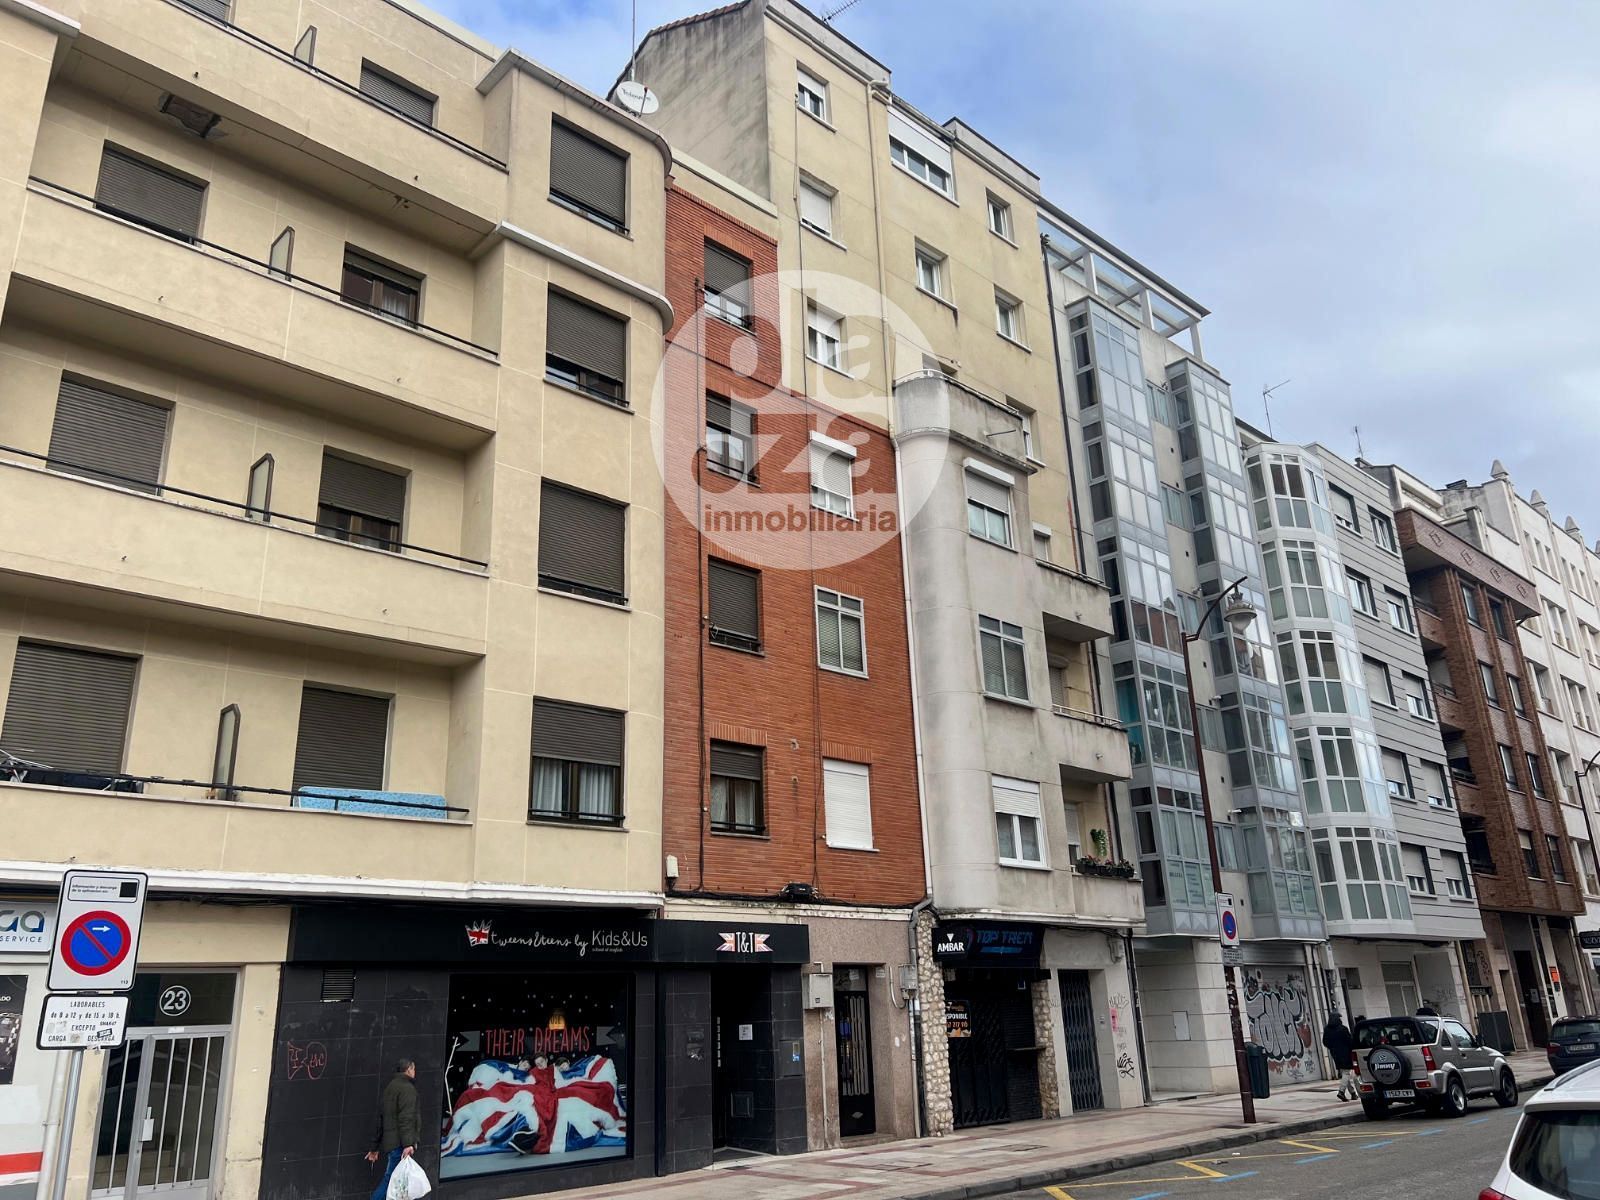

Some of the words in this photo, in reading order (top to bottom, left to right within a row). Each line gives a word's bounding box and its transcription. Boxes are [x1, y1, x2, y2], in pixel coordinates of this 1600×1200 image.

[591, 930, 648, 947] Kids&Us
[735, 931, 754, 953] T&T
[937, 942, 965, 953] AMBAR
[163, 990, 187, 1010] 23
[486, 1028, 525, 1057] THEIR
[534, 1025, 590, 1055] DREAMS
